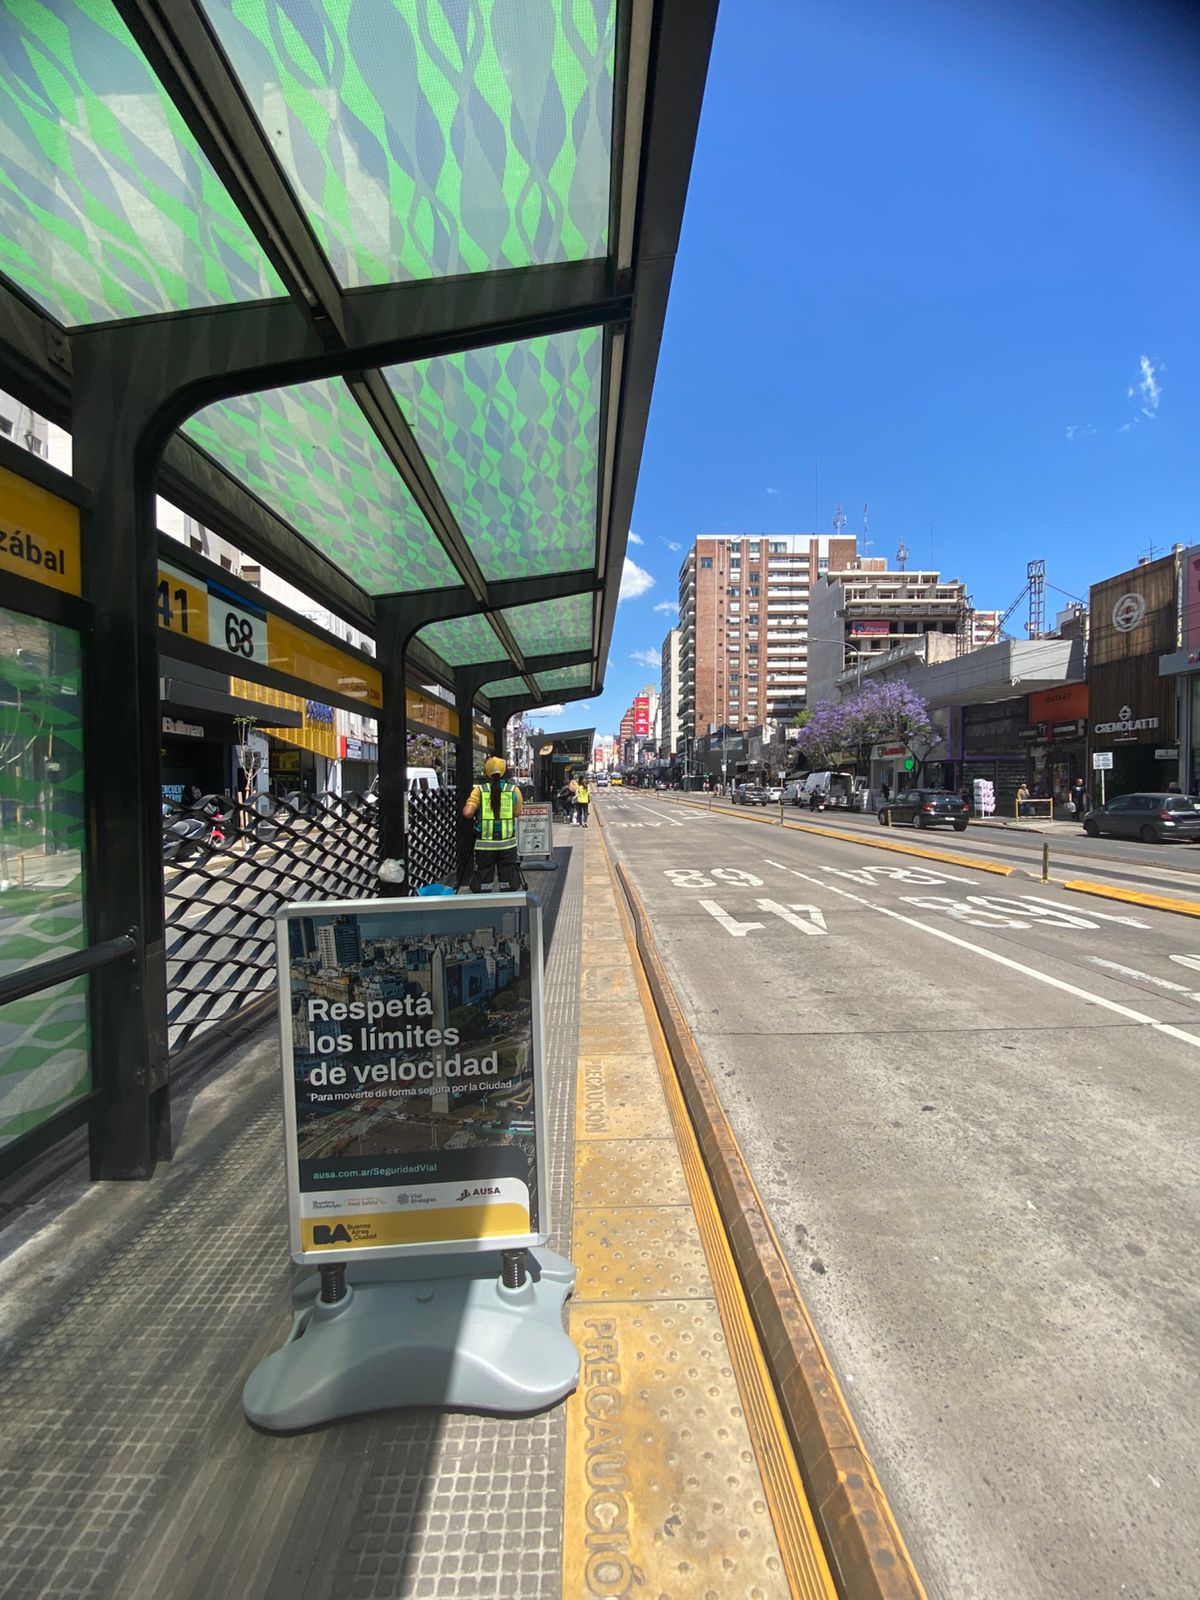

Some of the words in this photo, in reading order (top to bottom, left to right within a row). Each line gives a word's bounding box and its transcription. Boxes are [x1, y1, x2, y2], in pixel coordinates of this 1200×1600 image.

[155, 579, 189, 633] 41
[225, 612, 254, 659] 68
[1095, 717, 1159, 733] CREMOLATTI
[307, 992, 434, 1025] Respetá
[308, 1030, 353, 1055] los
[361, 1025, 460, 1051] límites
[310, 1062, 347, 1087] de
[354, 1051, 499, 1084] velocidad
[310, 1092, 334, 1102] Para
[334, 1090, 374, 1101] moverte
[375, 1088, 387, 1099] de
[388, 1087, 416, 1098] forma
[418, 1086, 450, 1099] segura
[452, 1083, 468, 1095] por
[469, 1082, 478, 1091] la
[479, 1079, 512, 1090] Ciudad
[313, 1162, 437, 1180] ausa.com.ar/SeguridadVial
[472, 1187, 501, 1196] AUSA
[353, 1233, 377, 1241] Ciudad
